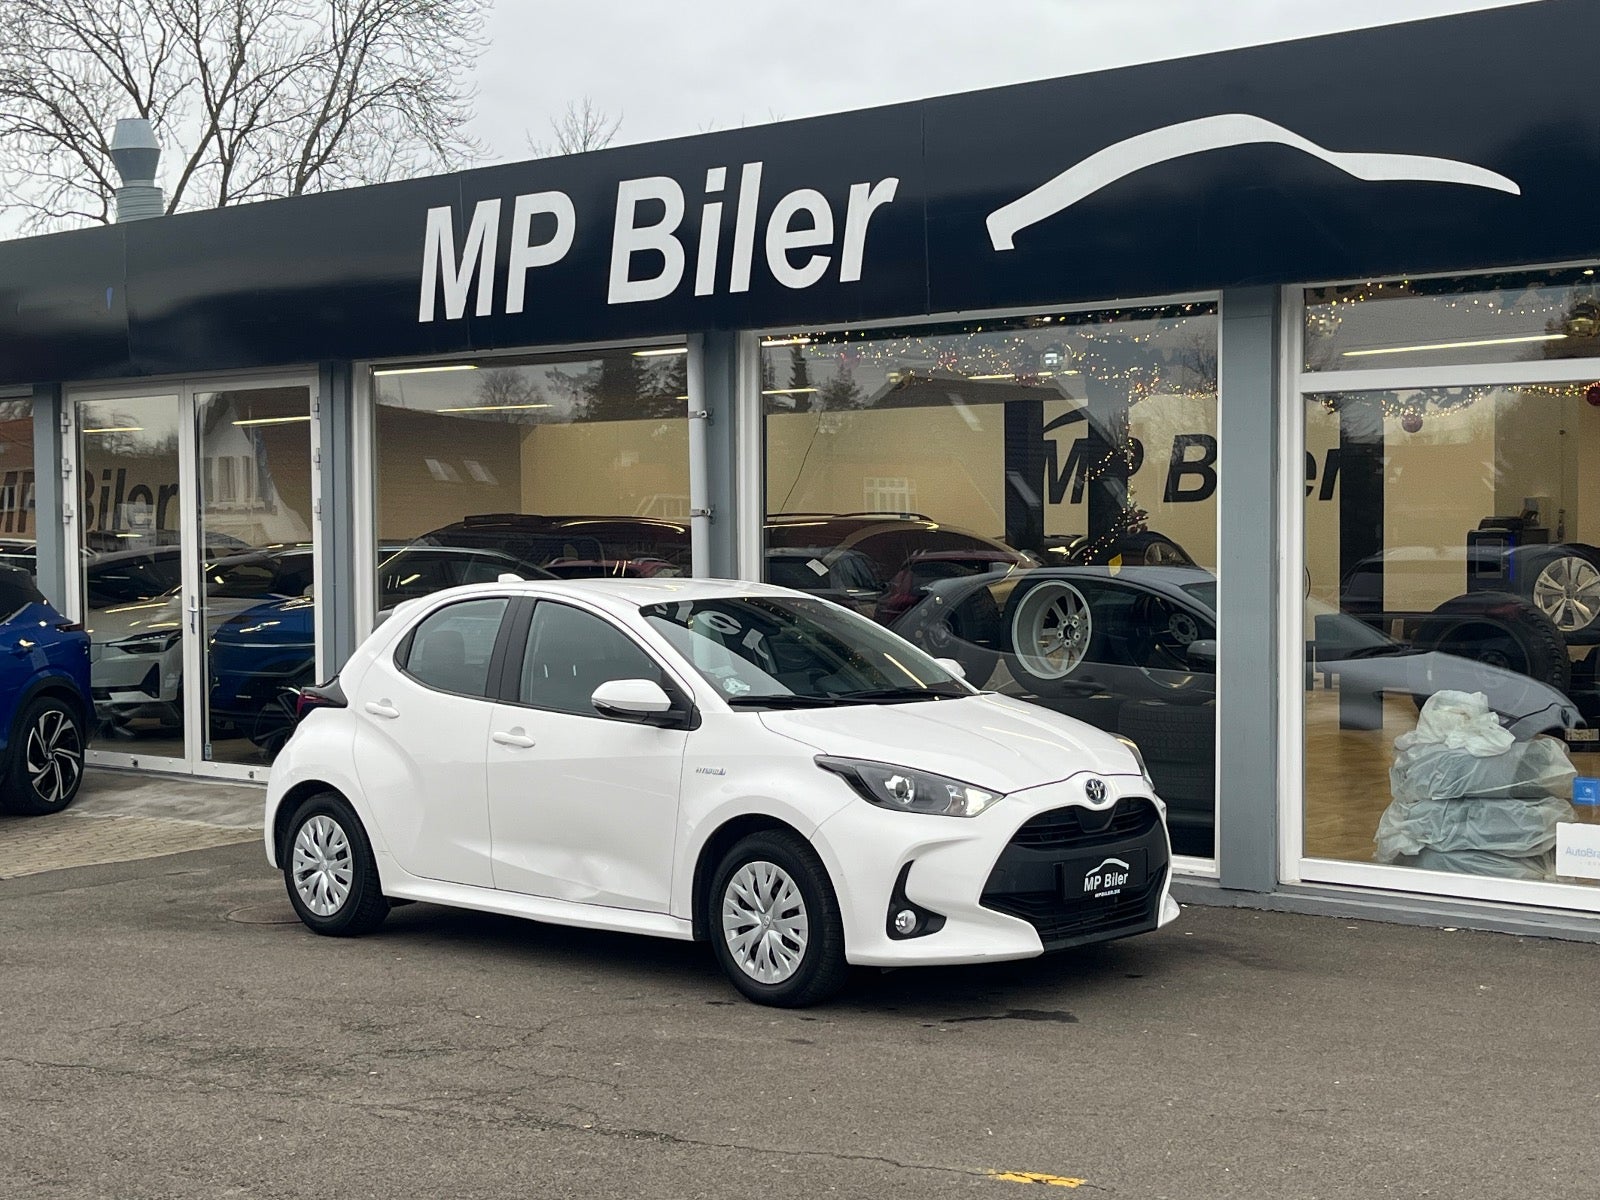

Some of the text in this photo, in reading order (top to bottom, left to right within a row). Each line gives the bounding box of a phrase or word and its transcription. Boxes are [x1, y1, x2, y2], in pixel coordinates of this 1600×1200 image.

[418, 161, 899, 322] MP Biler
[1083, 872, 1129, 892] MP Biler
